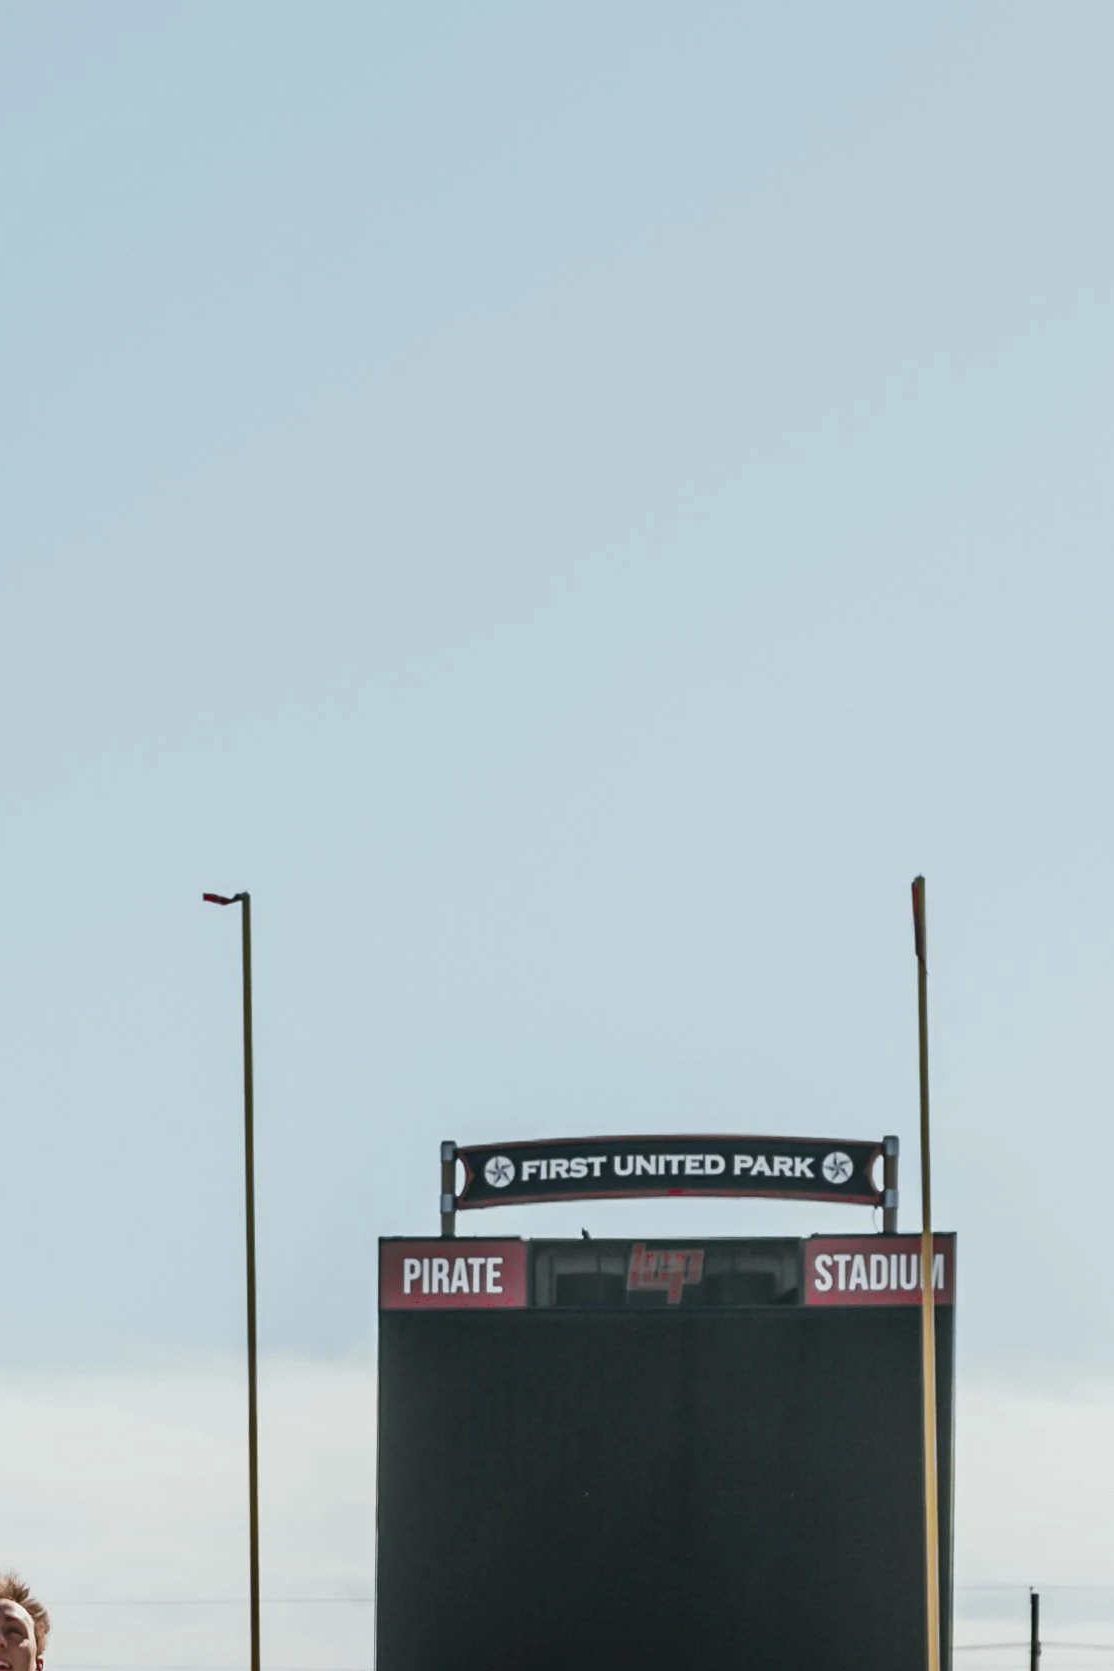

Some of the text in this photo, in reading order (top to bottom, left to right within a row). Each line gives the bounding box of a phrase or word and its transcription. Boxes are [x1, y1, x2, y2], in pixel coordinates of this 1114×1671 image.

[521, 1153, 816, 1182] FIRST UNITED PARK
[403, 1257, 504, 1294] PIRATE
